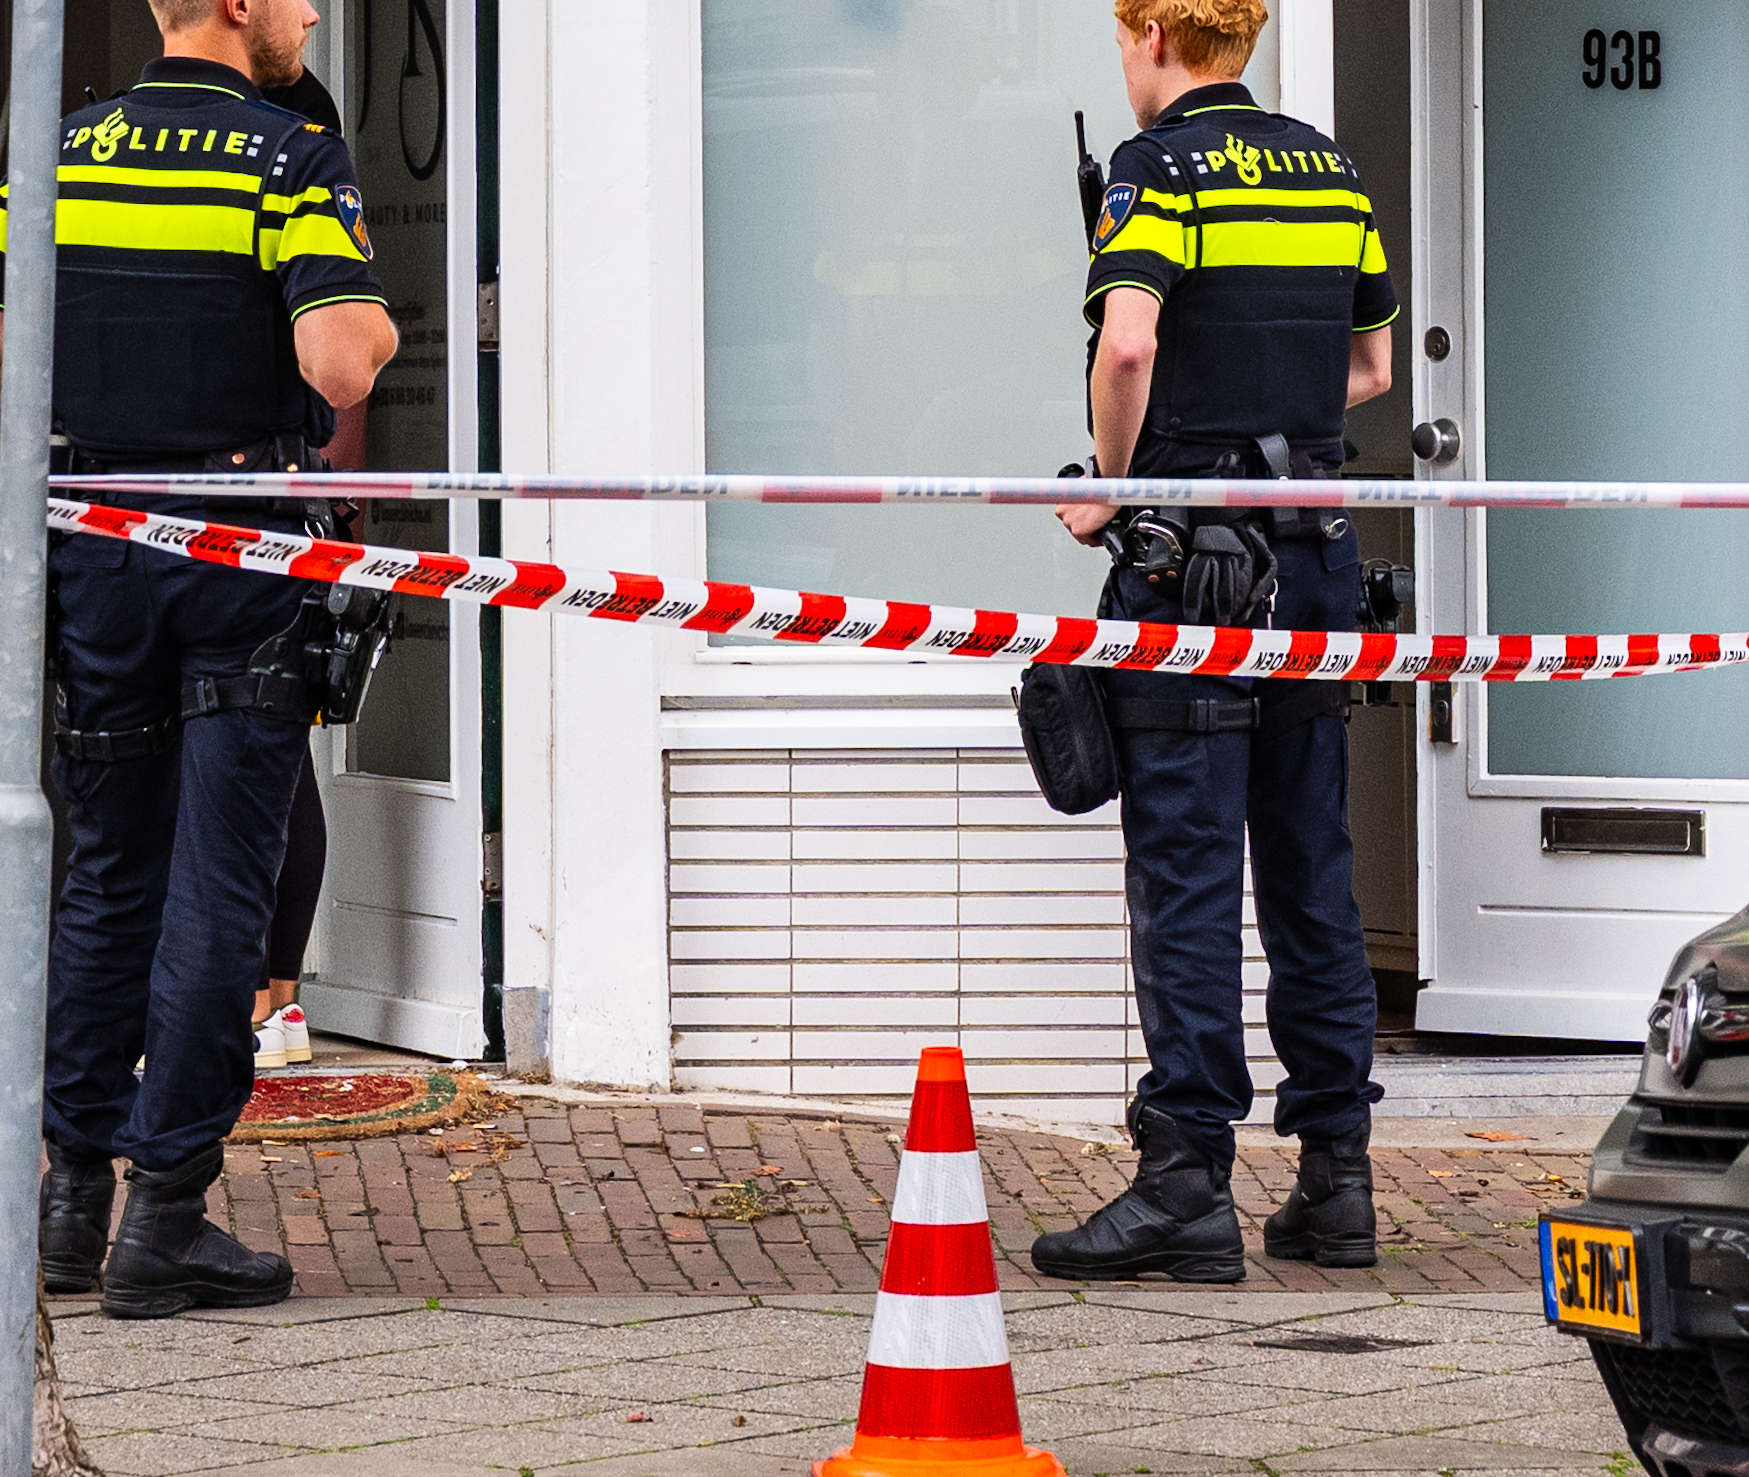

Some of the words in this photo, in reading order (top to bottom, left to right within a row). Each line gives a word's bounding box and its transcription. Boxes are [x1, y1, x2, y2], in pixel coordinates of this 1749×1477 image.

[1582, 28, 1662, 91] 93B
[246, 539, 304, 562] NIET
[361, 558, 469, 586] BETREDEN
[453, 573, 507, 595] NIET
[561, 588, 661, 616] BETREDEN
[648, 600, 698, 621] NIET
[749, 611, 842, 638] BETREDEN
[831, 621, 877, 640] NIET
[925, 629, 1014, 653] BETREDEN
[1003, 636, 1047, 656] NIET
[1092, 643, 1173, 666] BETREDEN
[1165, 647, 1206, 667] NIET
[1250, 652, 1323, 672] BETREDEN
[1317, 654, 1354, 673] NIET
[1459, 656, 1493, 674] NIET
